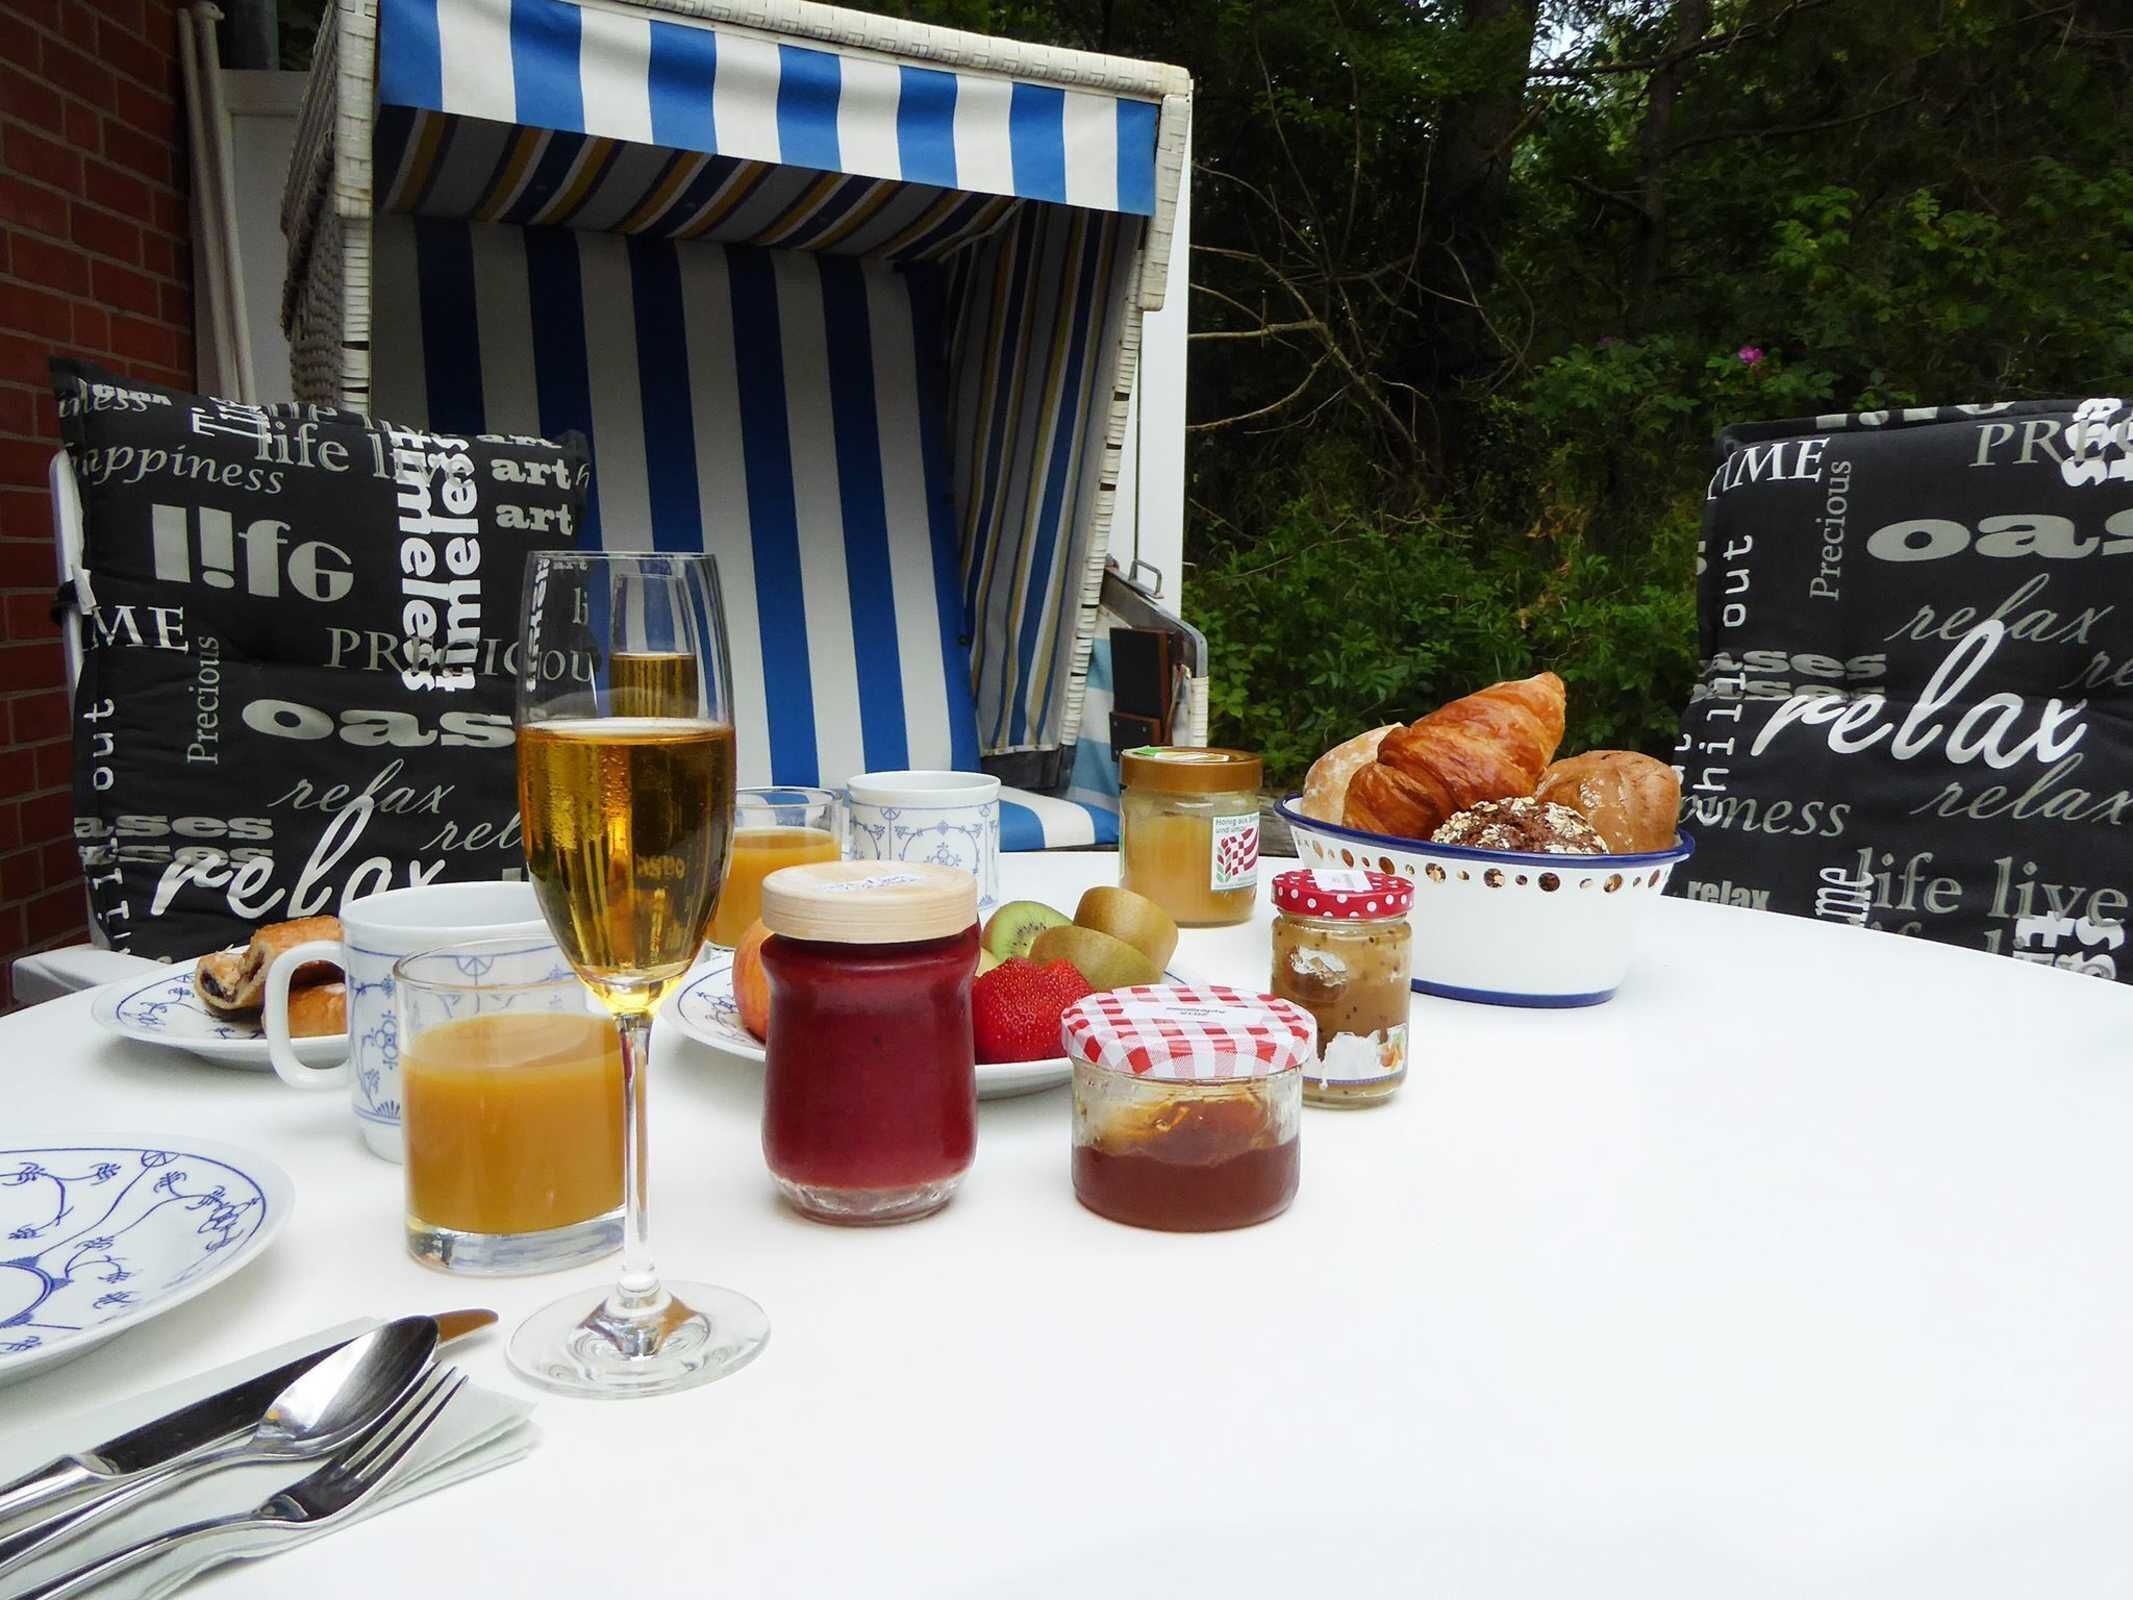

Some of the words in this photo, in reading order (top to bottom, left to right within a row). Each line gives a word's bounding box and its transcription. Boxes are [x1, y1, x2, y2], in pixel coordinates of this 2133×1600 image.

[255, 421, 350, 472] life
[490, 457, 572, 490] art
[496, 503, 573, 536] art
[1809, 460, 1851, 601] Precious
[1722, 534, 1753, 629] out
[1884, 572, 2115, 646] relax
[187, 636, 220, 765] Precious
[1750, 618, 2089, 769] relax
[84, 698, 115, 791] out
[268, 758, 456, 814] relax
[1910, 752, 2133, 826] relax
[150, 796, 447, 919] relax
[1857, 847, 1964, 914] life
[1987, 855, 2129, 928] live
[1687, 880, 1771, 912] relax
[1815, 867, 1875, 925] me
